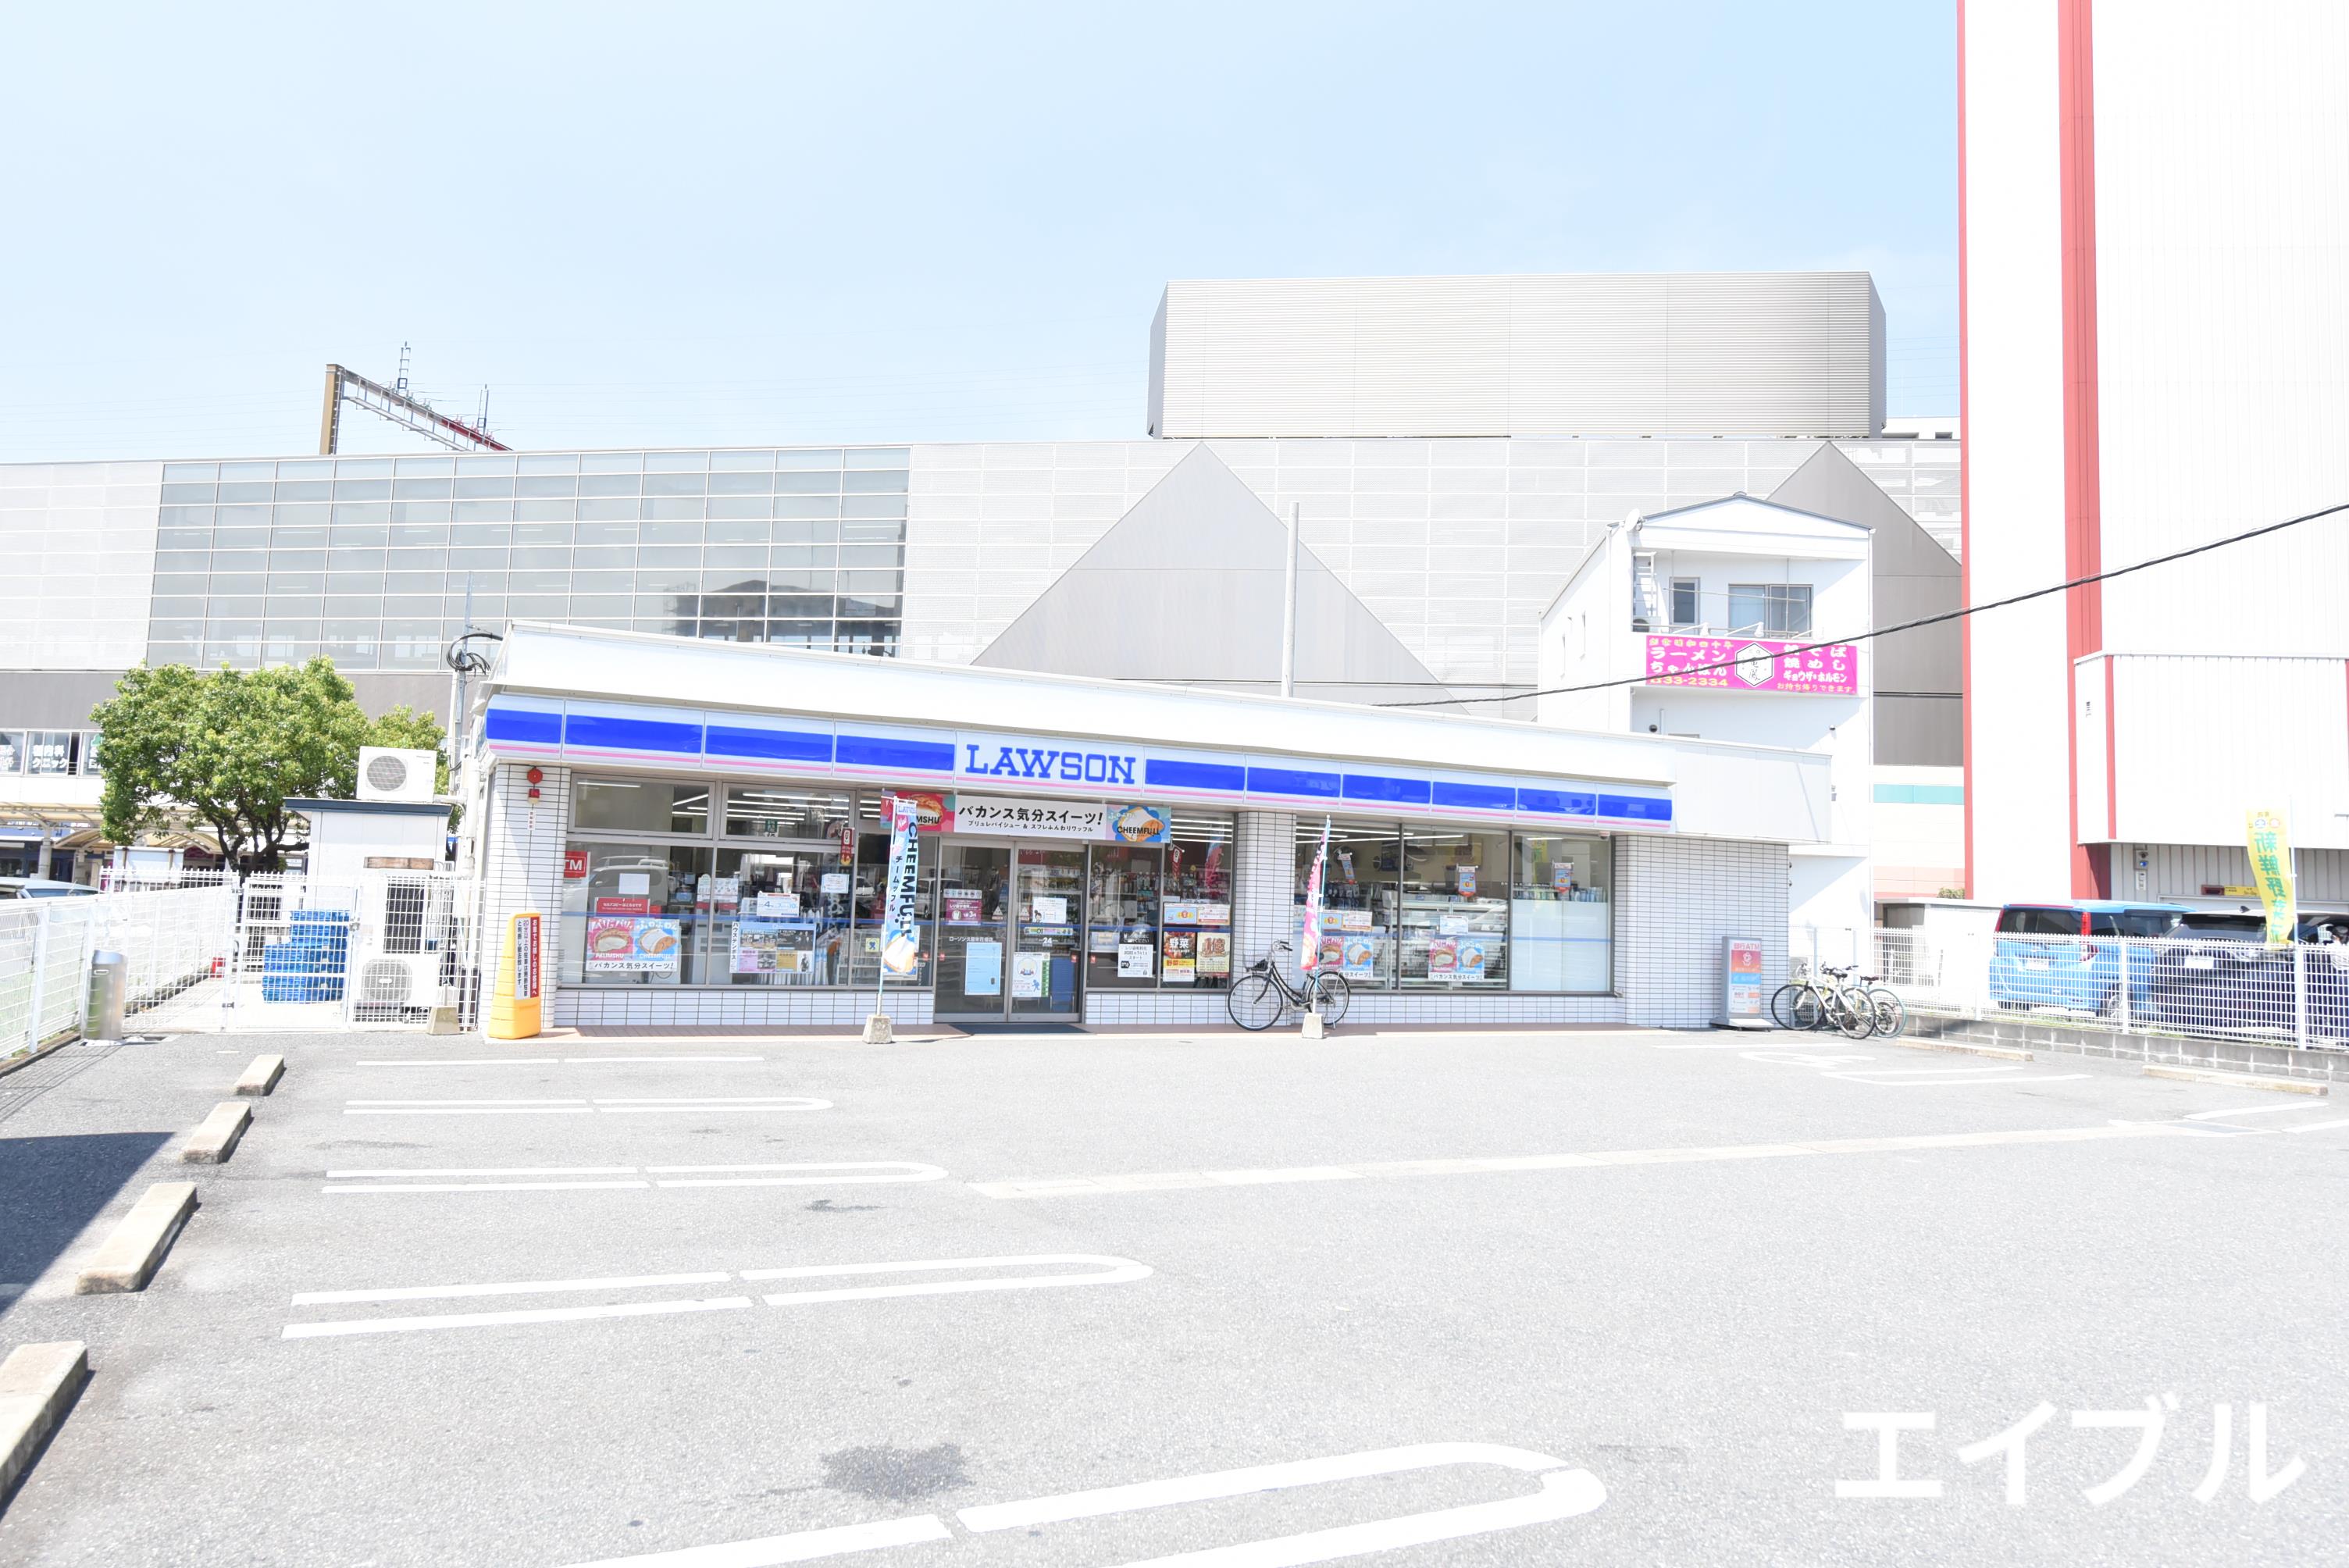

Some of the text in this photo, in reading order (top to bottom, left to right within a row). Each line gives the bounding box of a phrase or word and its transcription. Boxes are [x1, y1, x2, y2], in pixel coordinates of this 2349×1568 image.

[1650, 647, 1727, 661] ラーメン
[1650, 661, 1727, 677] ちゃんぽん
[1784, 657, 1845, 671] 焼めし
[965, 743, 1136, 785] LAWSON
[958, 805, 1103, 825] バカンス気分スイーツ!
[968, 820, 1021, 829] ブリュレパイシュー
[1030, 824, 1093, 832] スフレふんわりワッフル
[1169, 938, 1189, 949] 野菜
